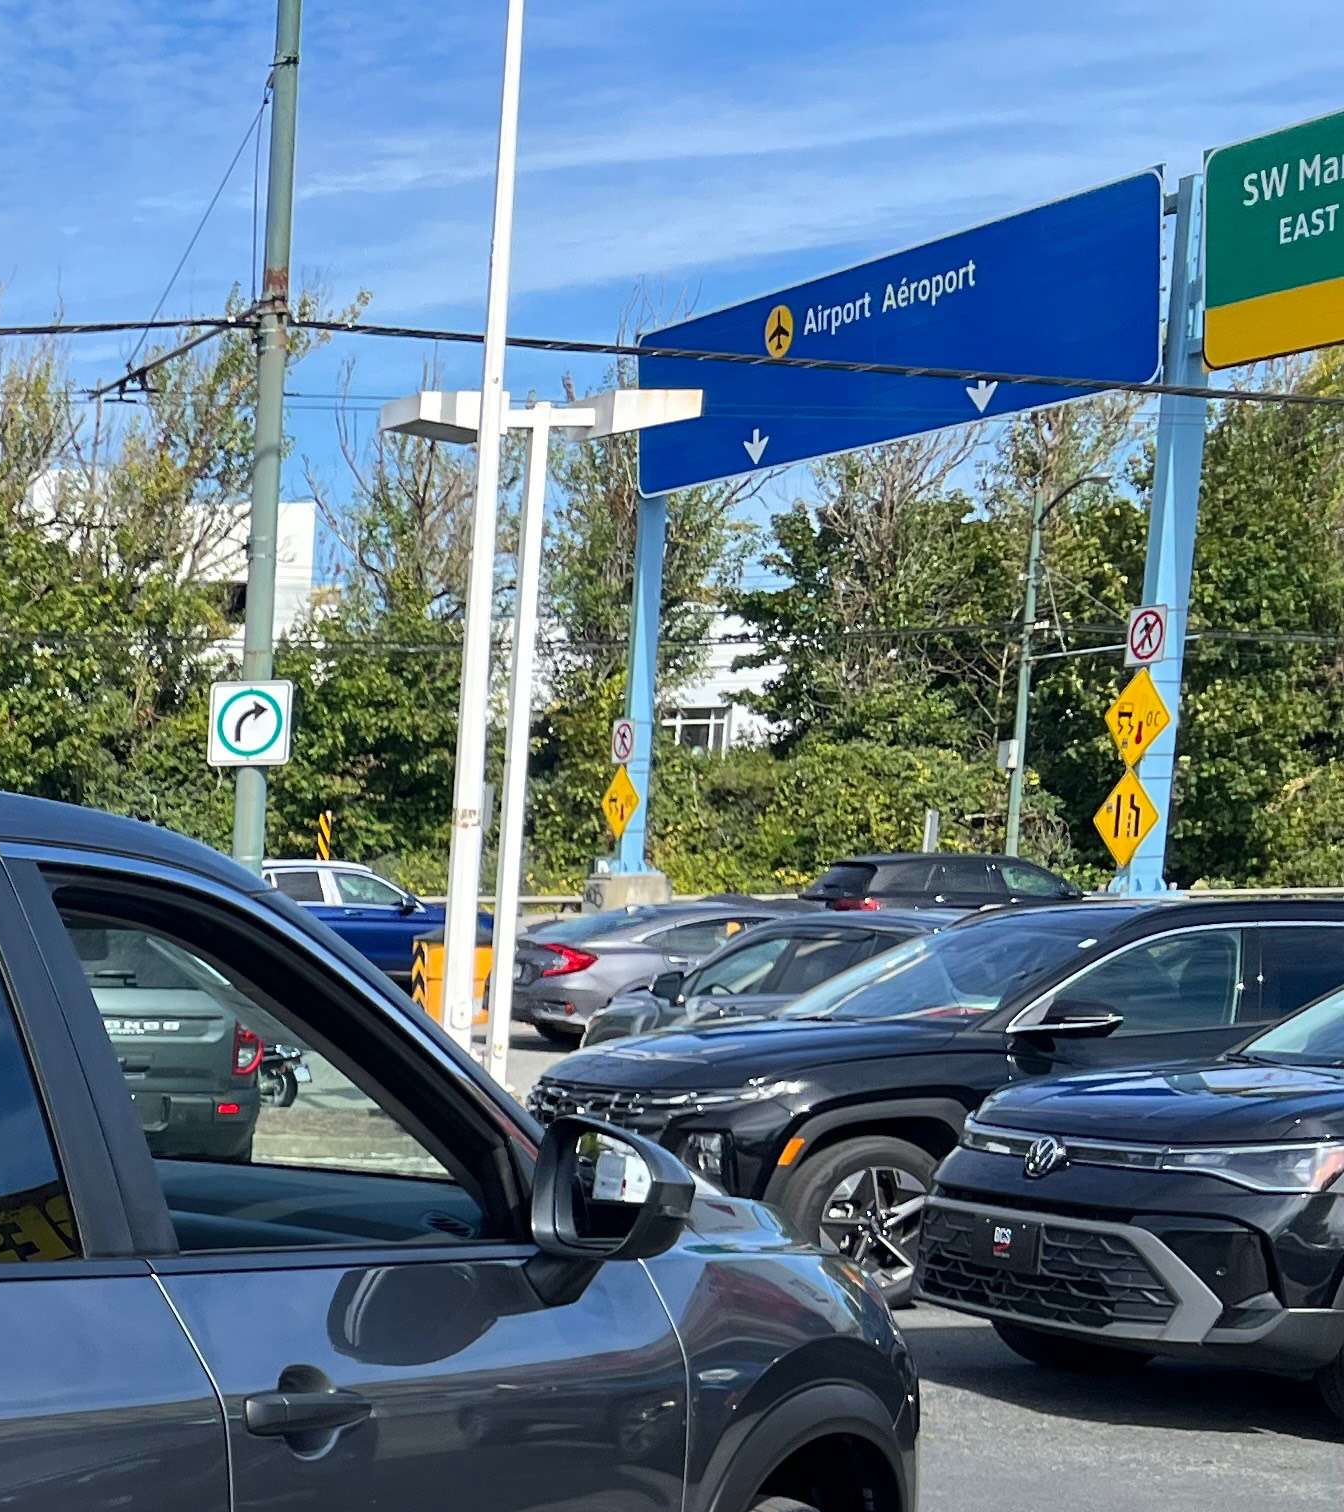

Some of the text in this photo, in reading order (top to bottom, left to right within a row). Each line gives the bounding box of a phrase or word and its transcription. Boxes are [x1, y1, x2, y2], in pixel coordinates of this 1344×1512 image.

[1242, 153, 1344, 206] SW Ma
[1279, 203, 1340, 245] EAST
[803, 259, 976, 335] Airport Aéroport
